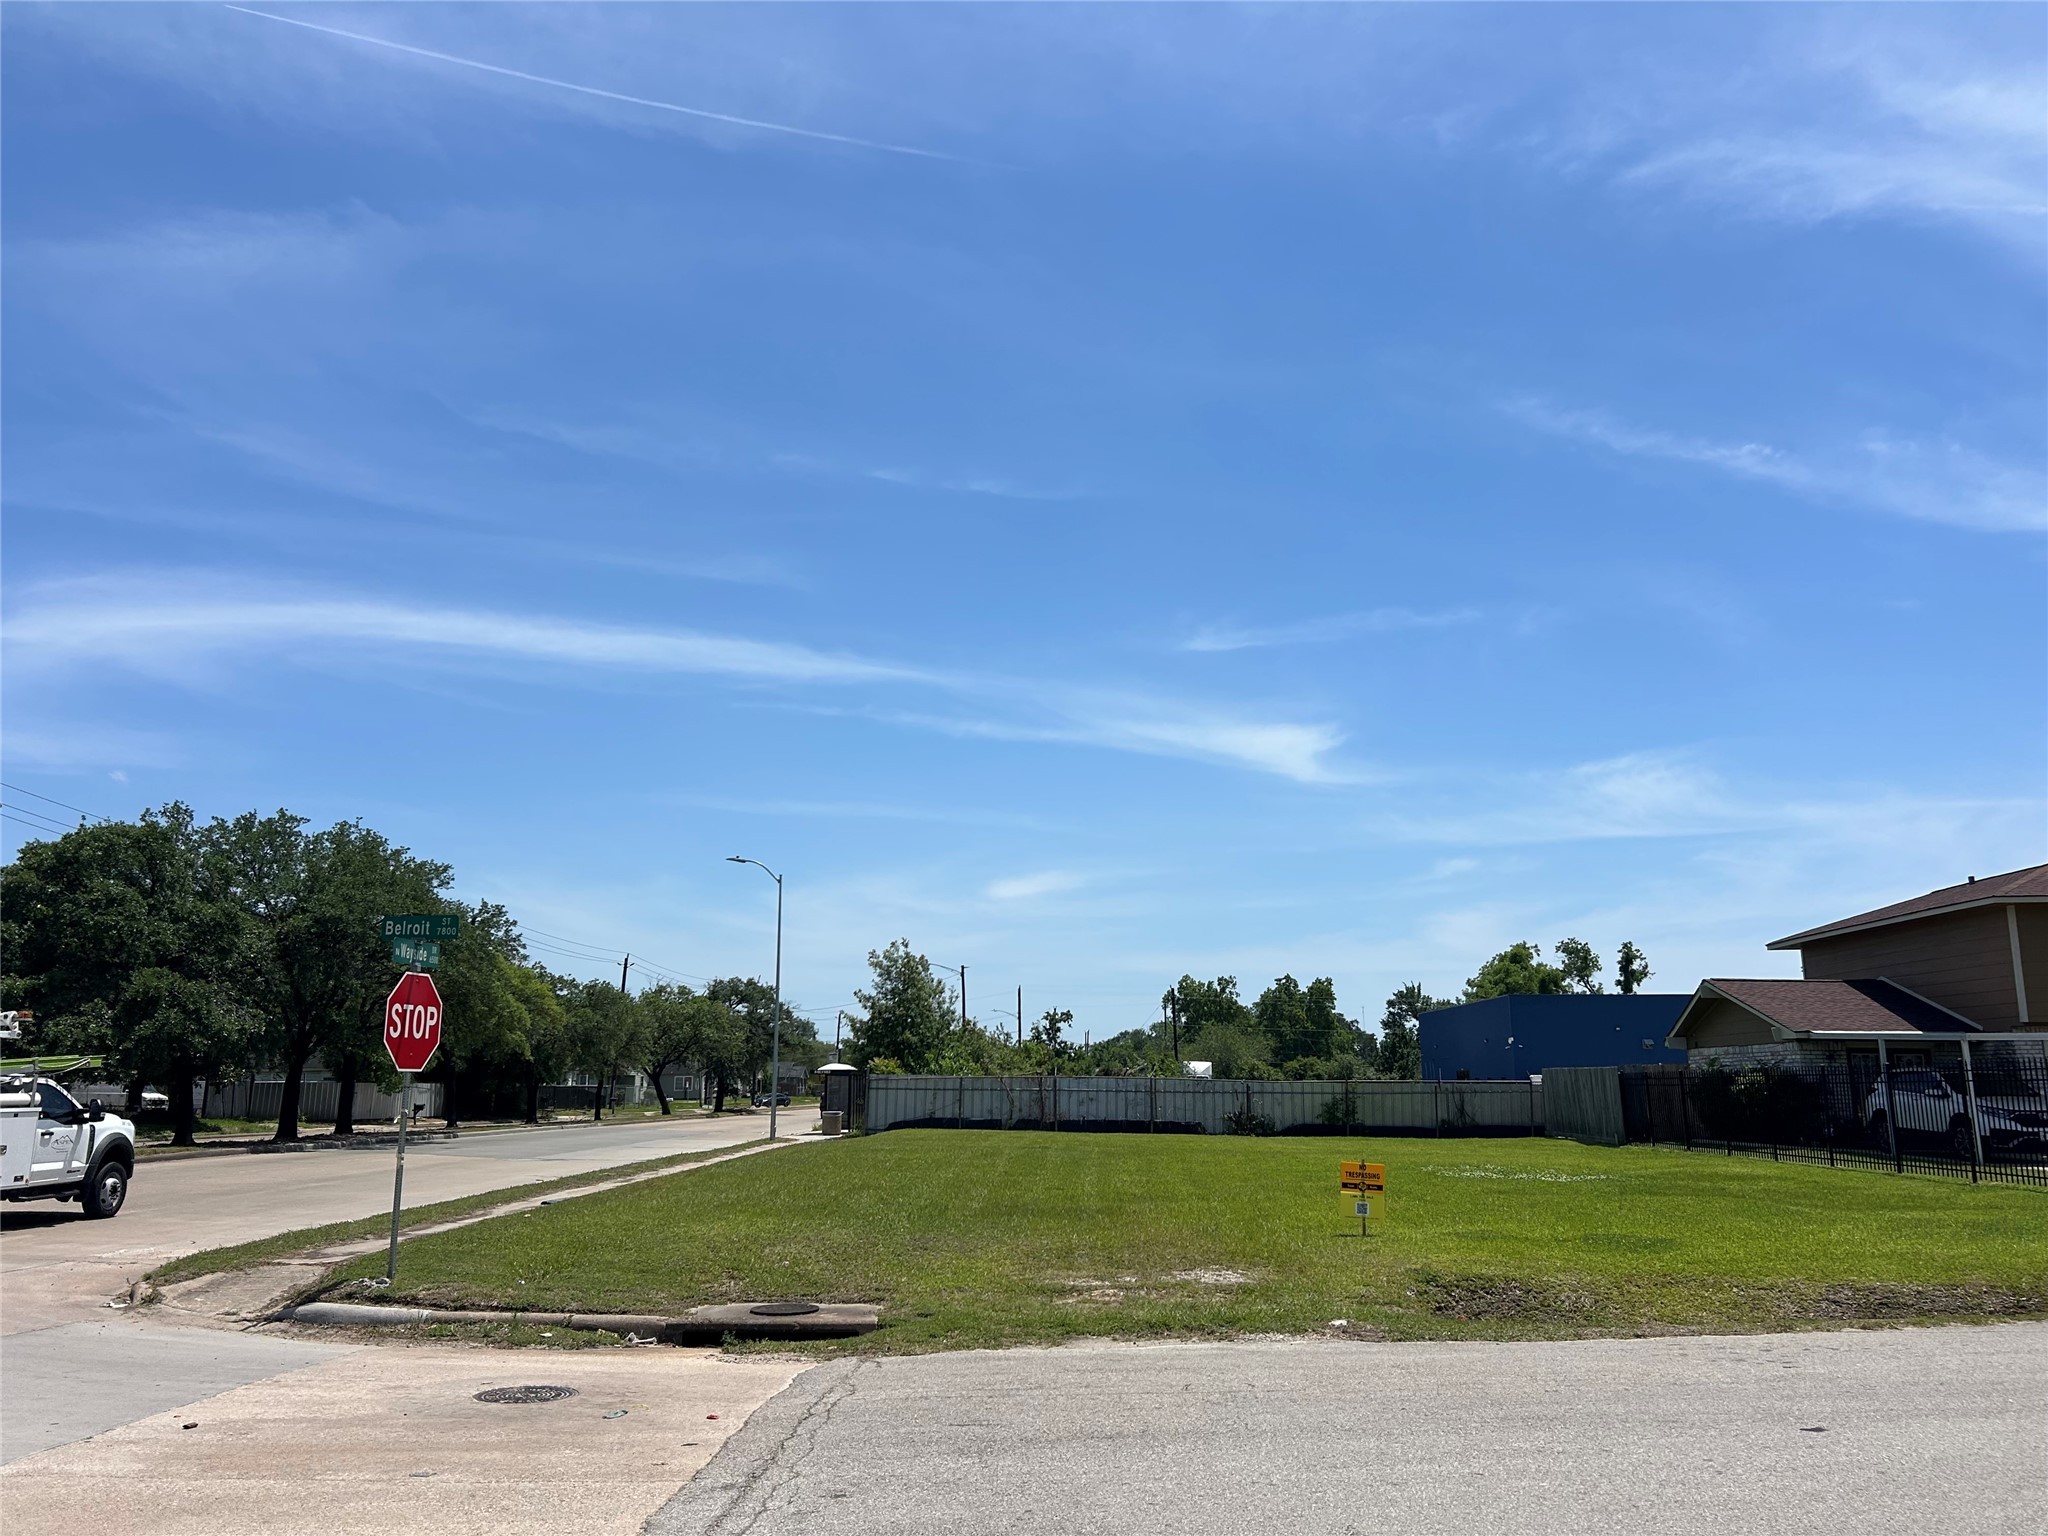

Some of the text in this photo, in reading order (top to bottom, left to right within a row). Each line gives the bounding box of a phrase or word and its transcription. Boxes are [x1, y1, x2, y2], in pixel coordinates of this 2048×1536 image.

[385, 920, 430, 935] Belroit
[400, 943, 427, 963] Wayside
[389, 1003, 438, 1039] STOP
[1345, 1171, 1380, 1180] TRESPASSING
